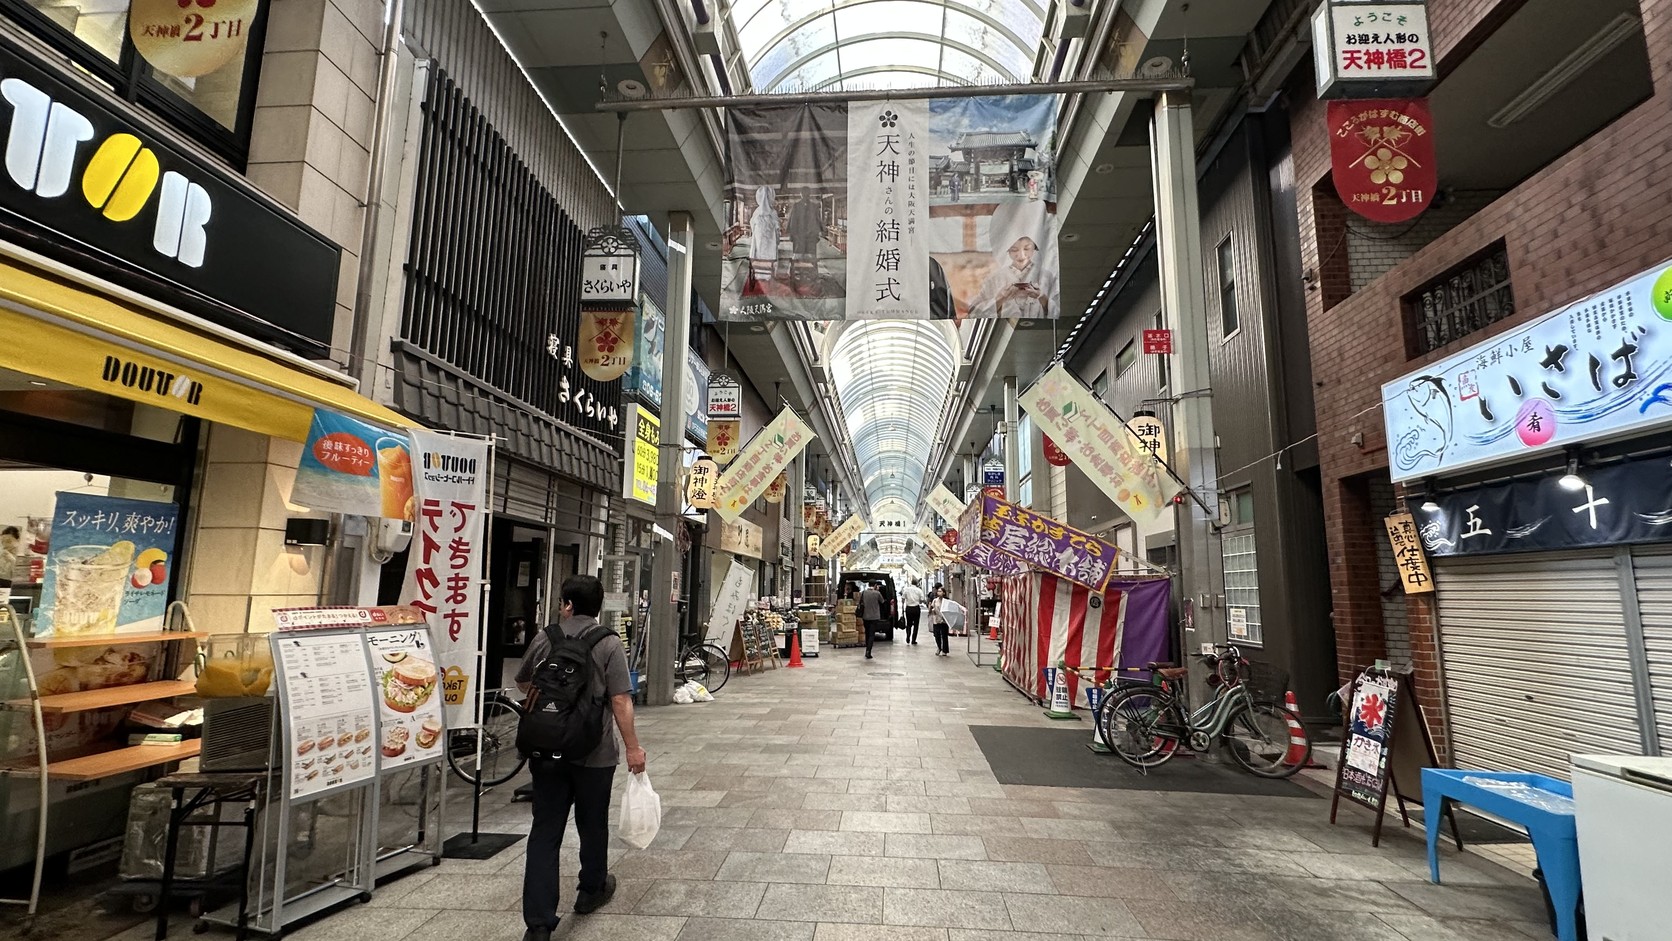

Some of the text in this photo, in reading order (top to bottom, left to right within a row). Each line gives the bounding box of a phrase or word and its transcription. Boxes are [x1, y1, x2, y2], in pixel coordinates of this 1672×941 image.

[1354, 12, 1408, 27] ようこそ
[1345, 33, 1419, 45] お迎え人形の
[1342, 48, 1427, 70] 天神橋2
[1351, 186, 1423, 205] 天神橋2丁目
[874, 132, 901, 303] 天神さんの結婚式
[583, 279, 632, 294] さくらいや
[1475, 335, 1534, 370] 海鮮小屋
[102, 355, 203, 405] DOUTOR
[1478, 325, 1647, 422] いさば
[558, 375, 618, 431] さくらいや
[321, 451, 370, 467] フルーティー
[322, 439, 370, 457] 後味すっきり
[691, 464, 709, 500] 御神燈
[367, 630, 418, 647] モーニング
[1360, 693, 1385, 729] 氷
